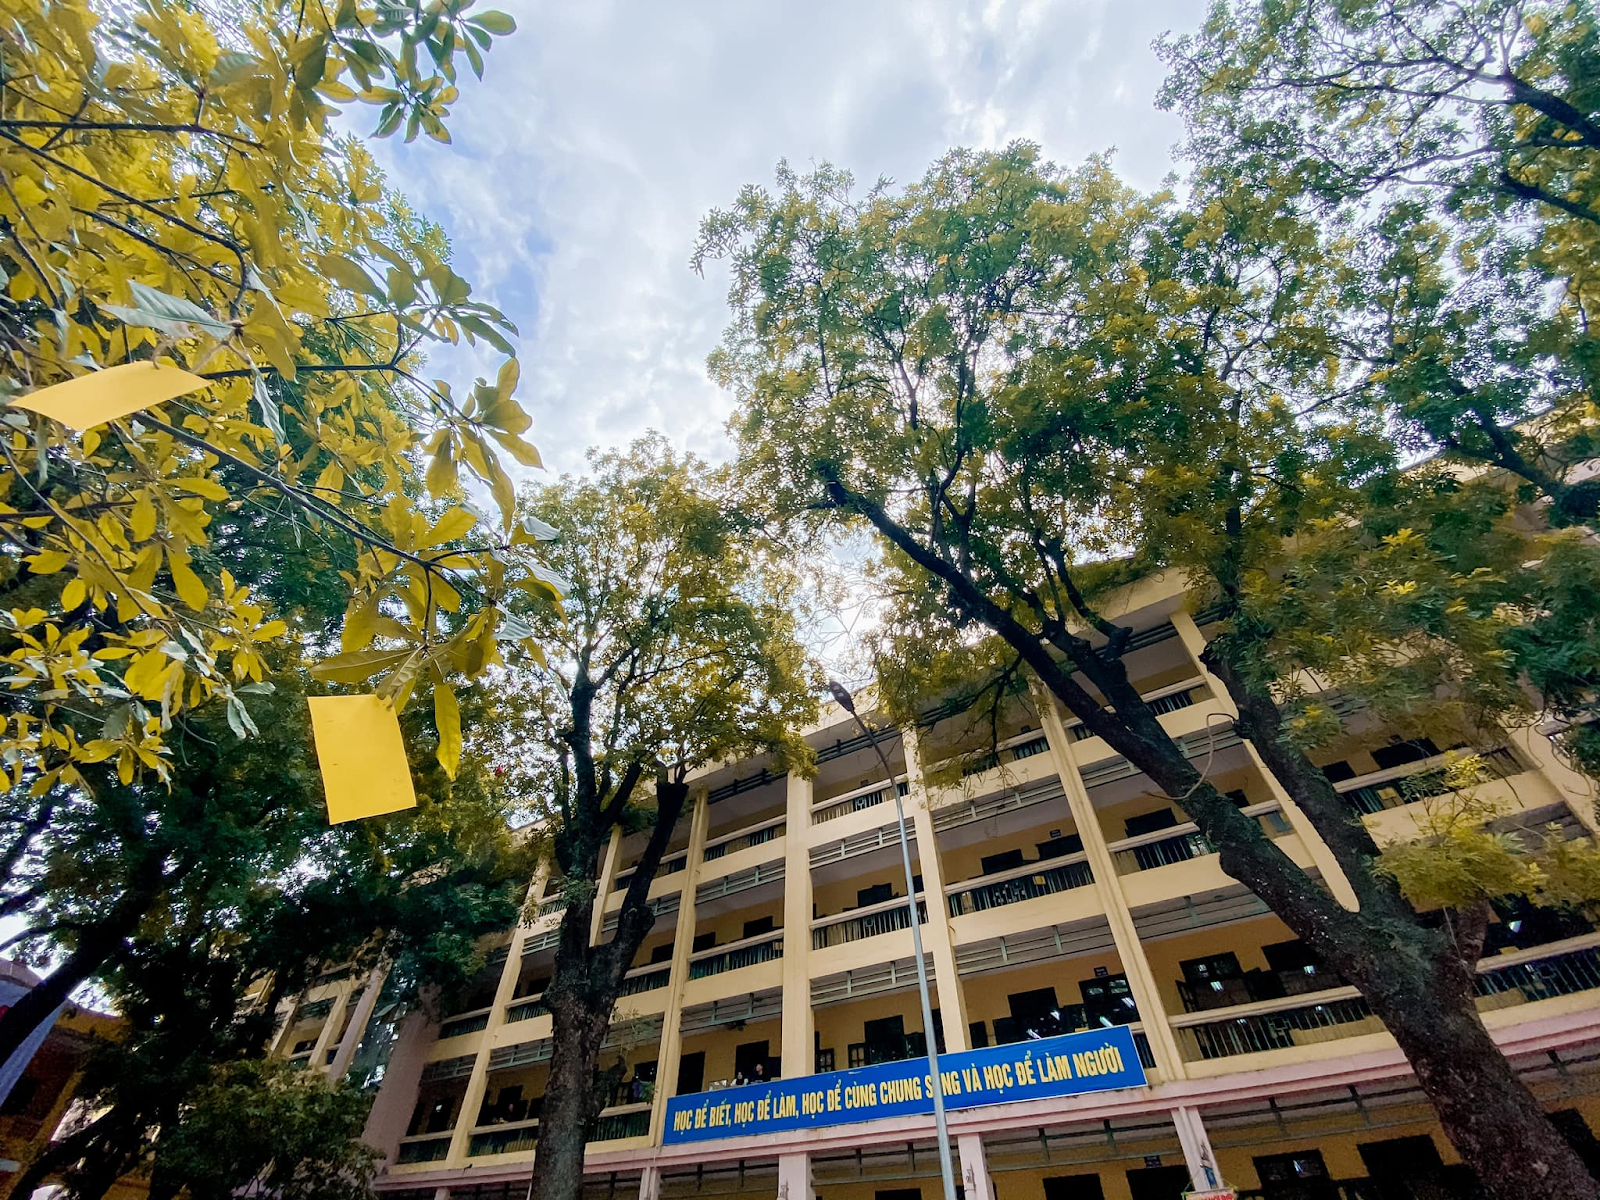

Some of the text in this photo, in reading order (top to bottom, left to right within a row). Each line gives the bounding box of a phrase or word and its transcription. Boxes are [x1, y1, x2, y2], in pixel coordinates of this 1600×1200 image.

[673, 1042, 1125, 1135] HỌC ĐỂ BIẾT, HỌC ĐỂ LÀM, HỌC ĐỂ CÙNG CHUNG SNG VÀ HỌC ĐỂ LÀM NGƯỜI
